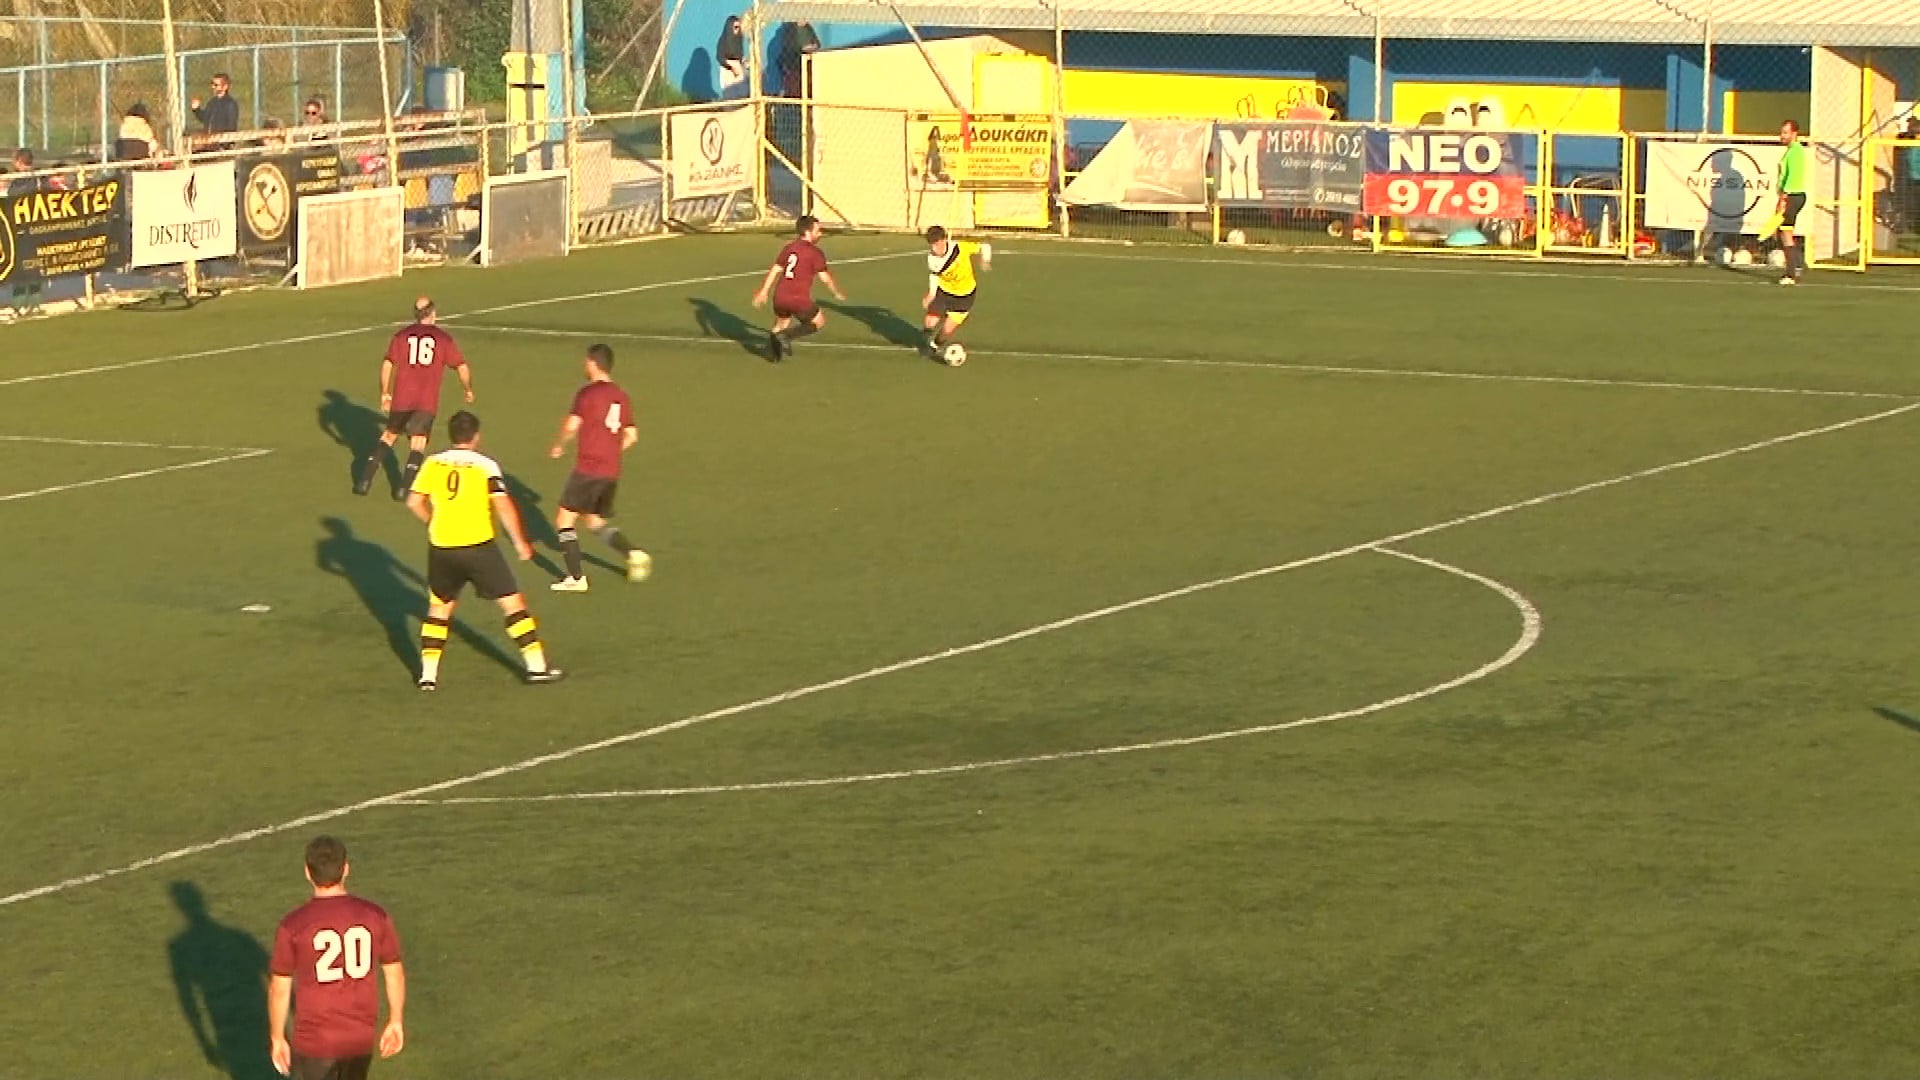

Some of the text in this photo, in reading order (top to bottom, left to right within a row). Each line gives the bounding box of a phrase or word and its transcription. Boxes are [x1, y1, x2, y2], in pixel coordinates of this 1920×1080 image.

[1686, 175, 1770, 191] NISSAN
[149, 218, 221, 248] DISTRETTO
[784, 253, 798, 279] 2
[407, 335, 436, 366] 16
[604, 403, 622, 433] 4
[447, 469, 460, 500] 9
[313, 925, 372, 983] 20
